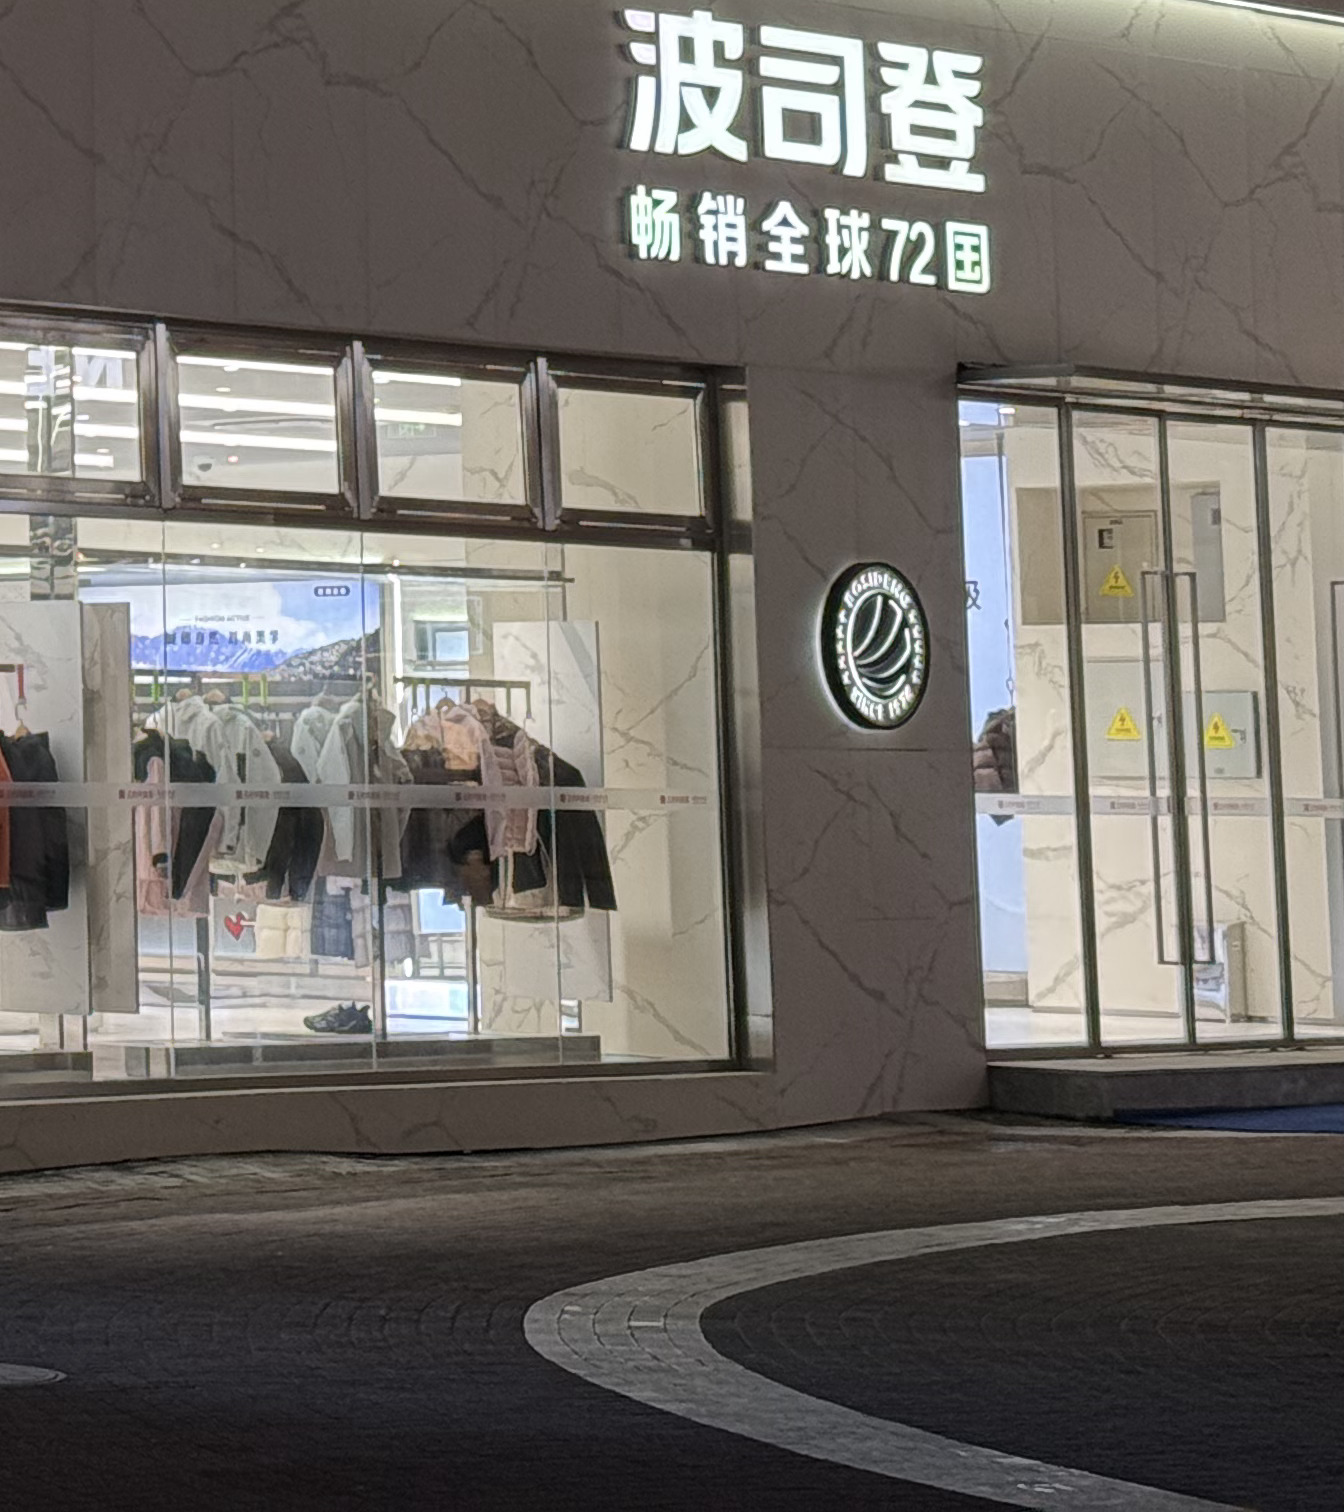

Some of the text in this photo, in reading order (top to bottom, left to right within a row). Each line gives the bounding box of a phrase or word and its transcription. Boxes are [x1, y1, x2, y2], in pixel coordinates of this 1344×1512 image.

[622, 8, 988, 194] 波司登
[627, 184, 992, 295] 畅销全球72国
